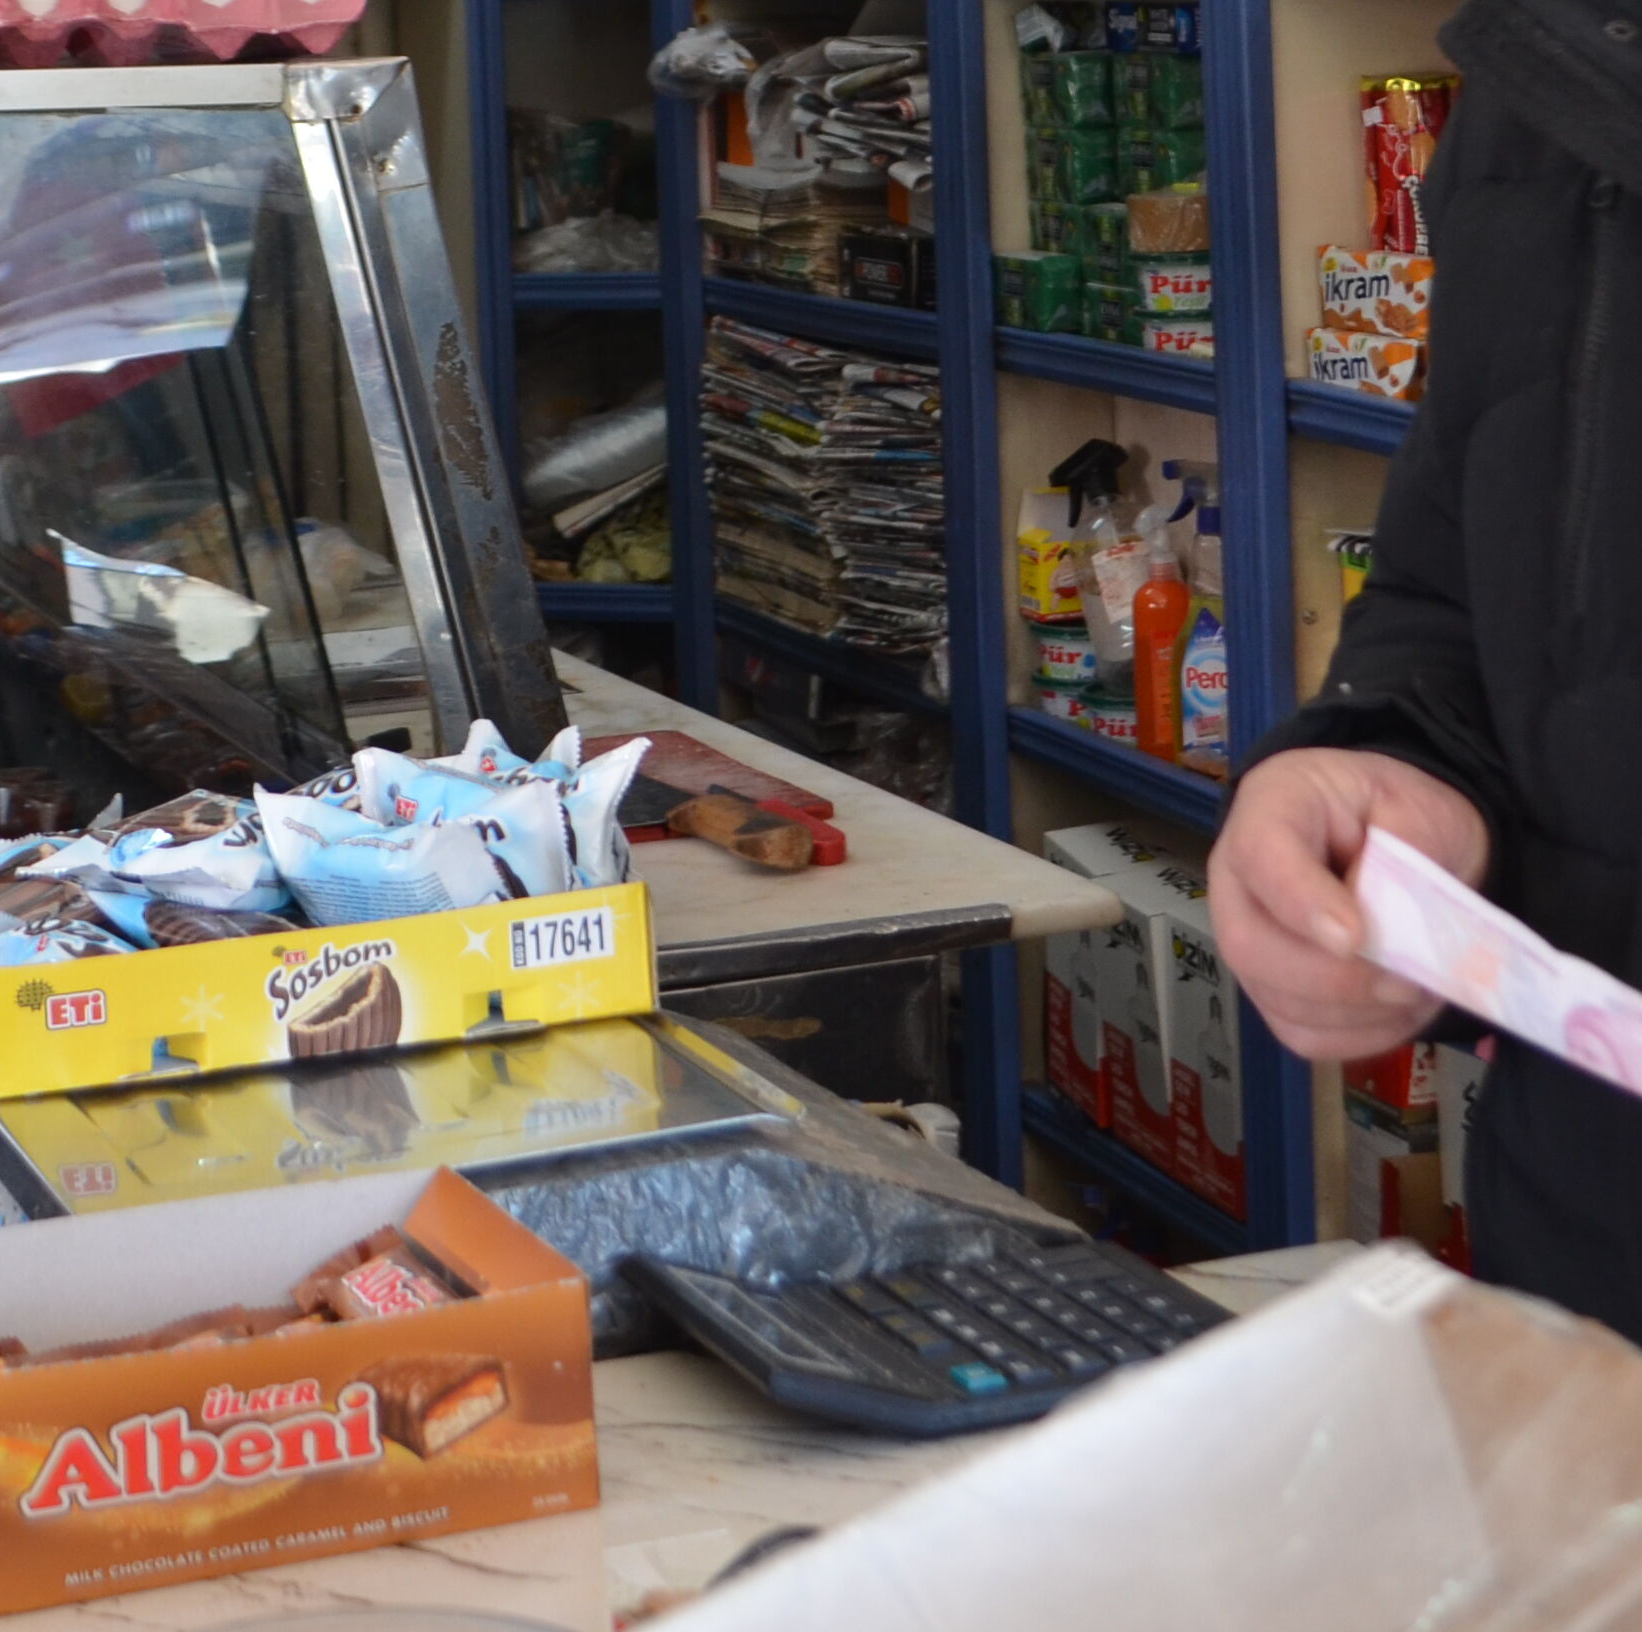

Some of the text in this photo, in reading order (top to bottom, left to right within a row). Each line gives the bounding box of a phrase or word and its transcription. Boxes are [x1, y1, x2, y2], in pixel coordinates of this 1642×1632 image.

[1323, 272, 1390, 304] ikram
[1313, 352, 1369, 382] ikram
[528, 912, 605, 961] 17641
[203, 1379, 320, 1423] ÜLKER
[22, 1383, 383, 1518] Albeni
[63, 1504, 451, 1588] MILK CHOCOLATE COATED CARAMEL AND BISCUIT
